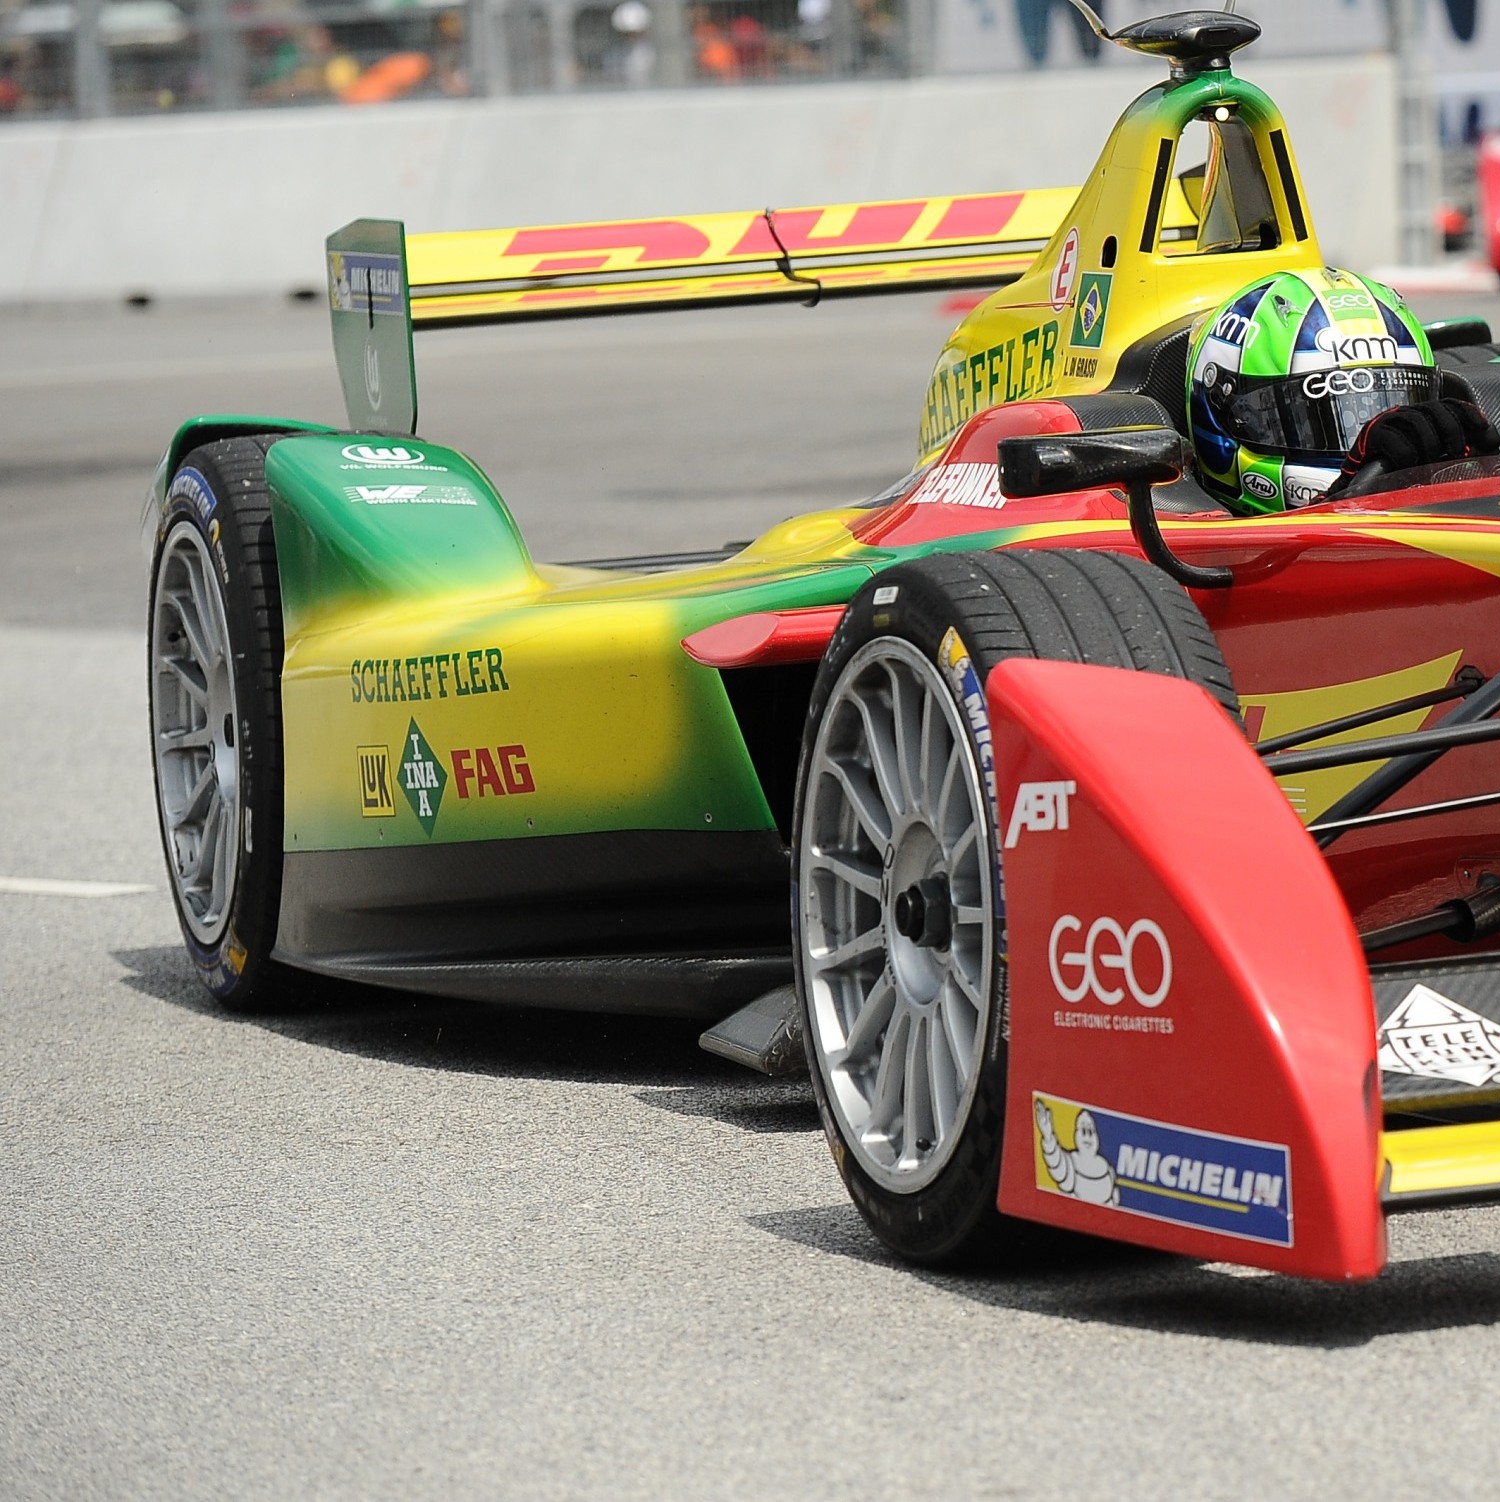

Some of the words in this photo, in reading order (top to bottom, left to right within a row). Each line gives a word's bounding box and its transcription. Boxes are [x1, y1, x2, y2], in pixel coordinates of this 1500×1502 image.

[1246, 476, 1272, 494] Arai
[351, 647, 510, 703] SCHAEFFLER
[404, 761, 439, 789] INA
[450, 744, 536, 799] FAG
[1004, 780, 1077, 849] ABT
[1048, 914, 1173, 1009] GEO
[1054, 1010, 1112, 1031] ELECTRONIC
[1113, 1015, 1175, 1034] CIGARETTES
[1396, 1030, 1478, 1050] TELE
[1117, 1143, 1284, 1208] MICHELIN
